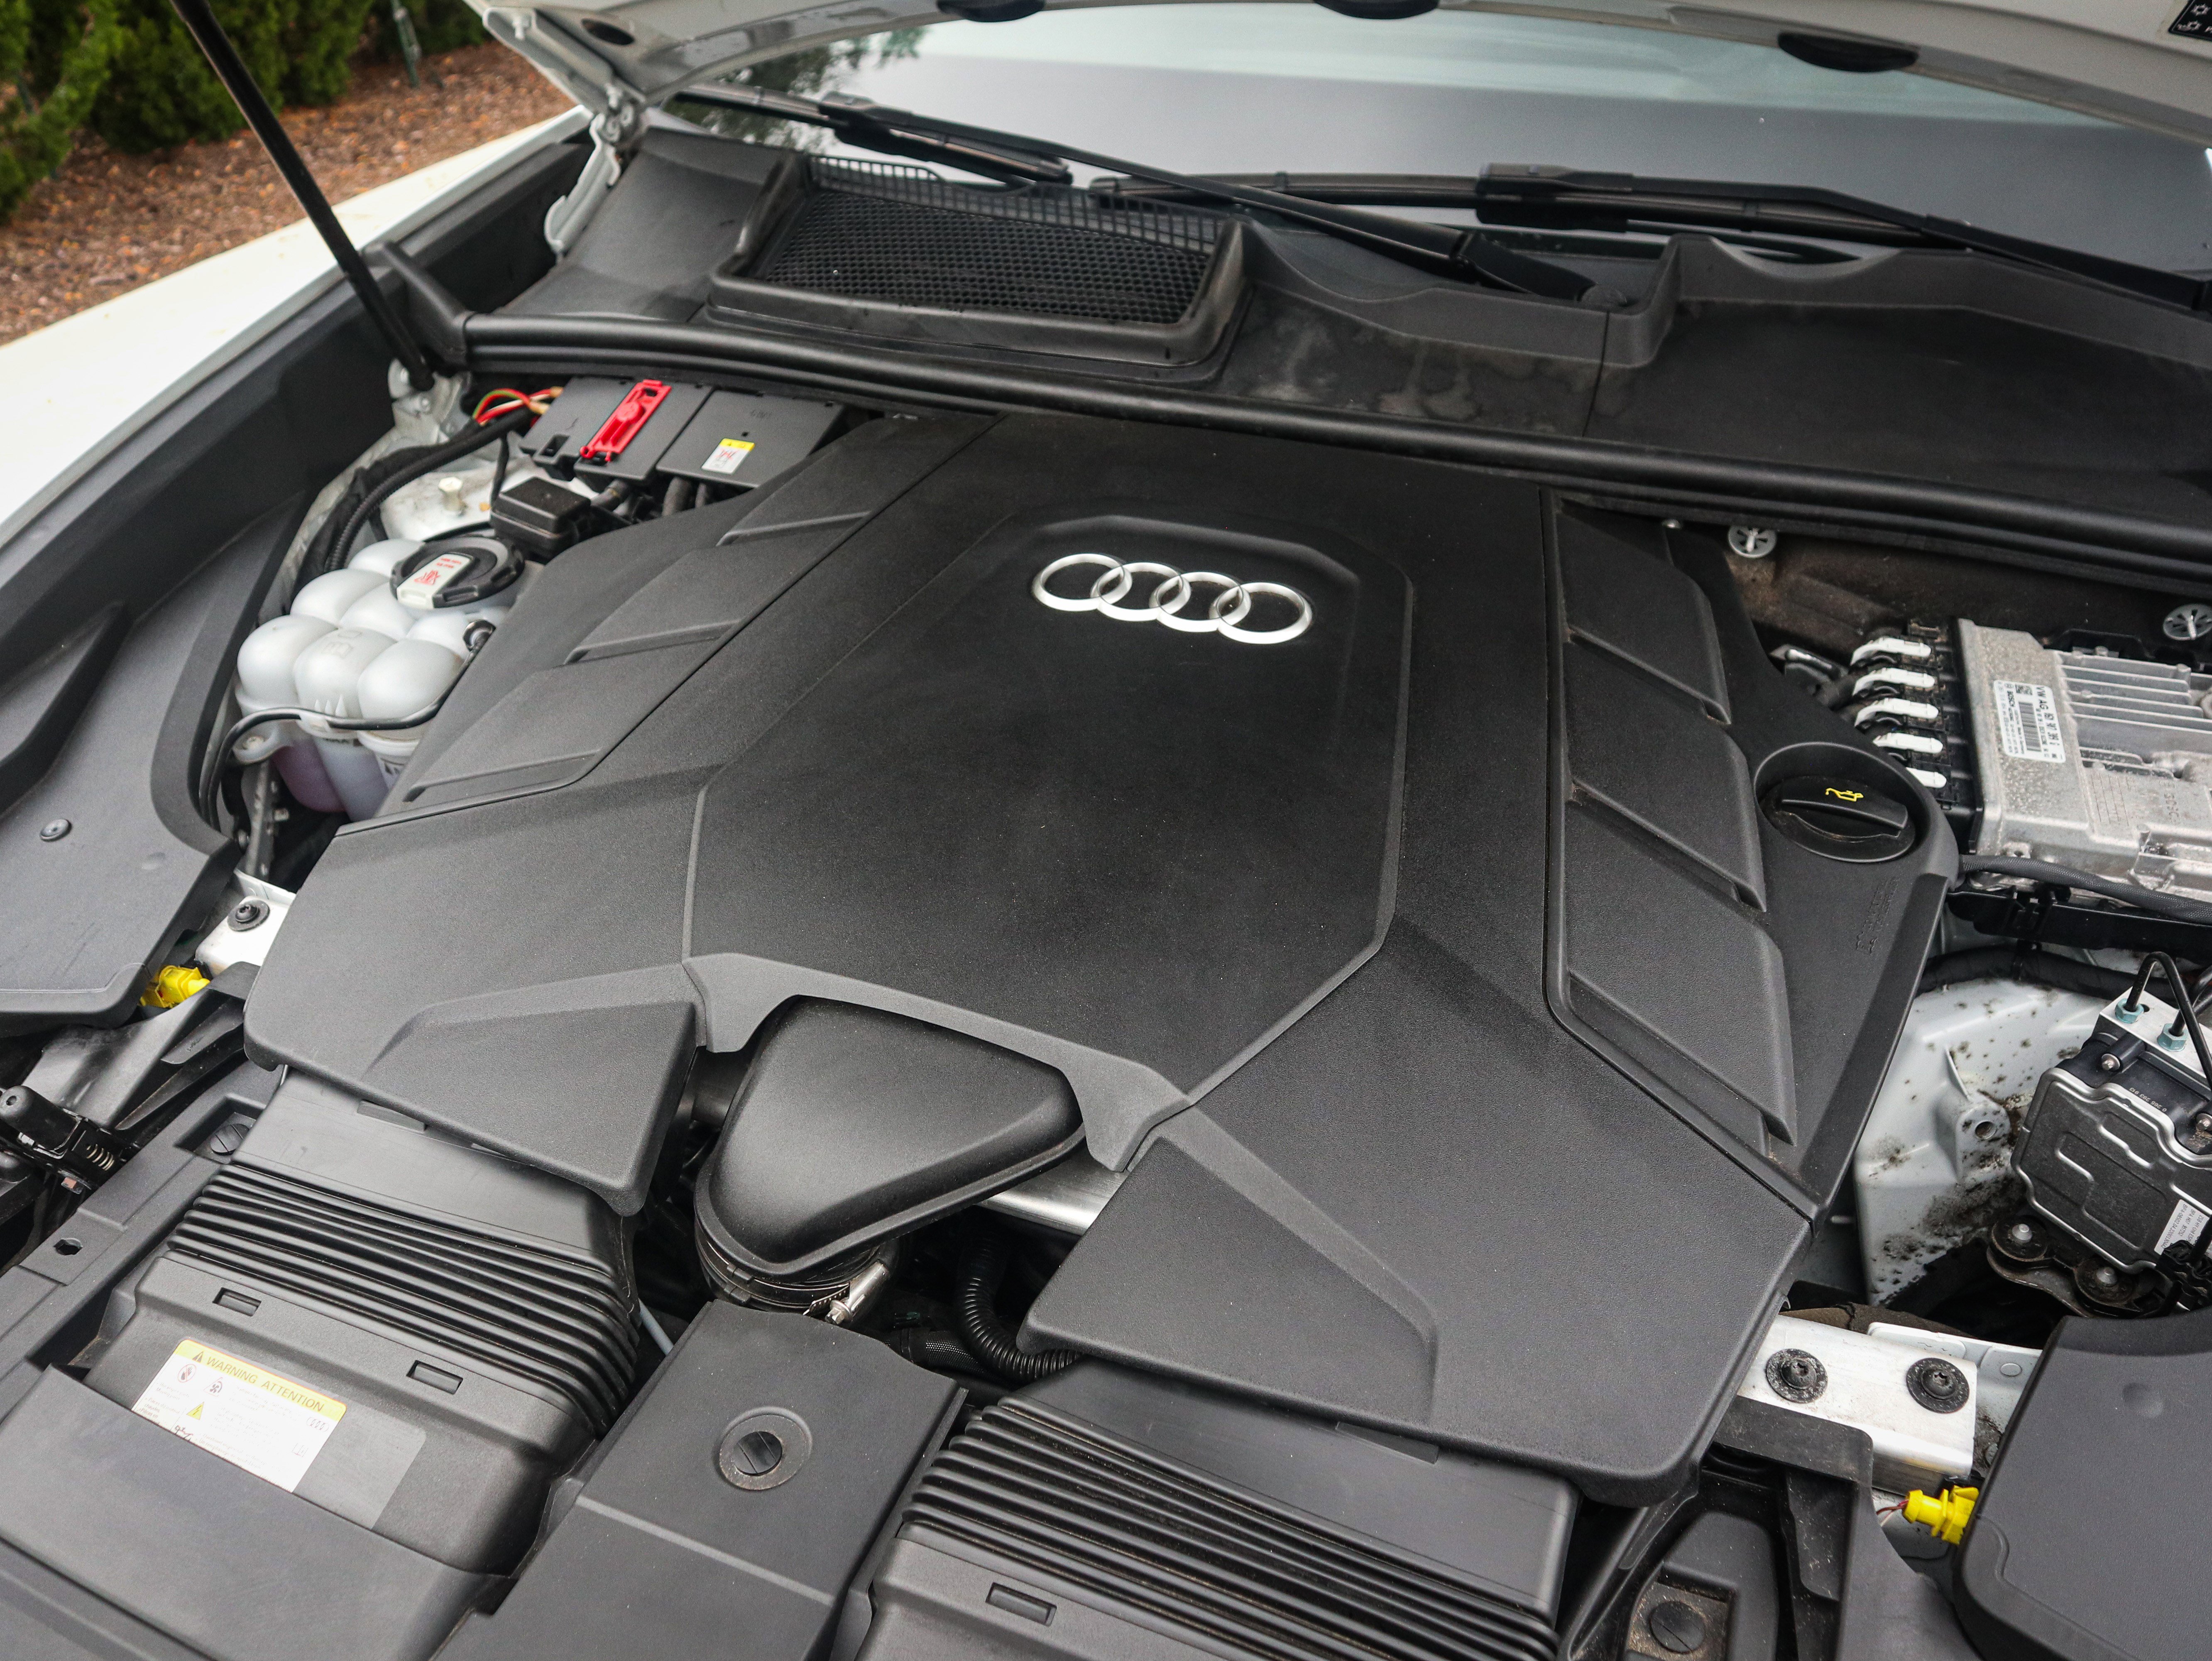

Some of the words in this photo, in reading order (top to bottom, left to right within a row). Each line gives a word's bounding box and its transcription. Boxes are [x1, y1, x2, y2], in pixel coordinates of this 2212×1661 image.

[2038, 699, 2048, 710] AG
[207, 1357, 258, 1384] WARNING
[261, 1380, 324, 1412] ATTENTION
